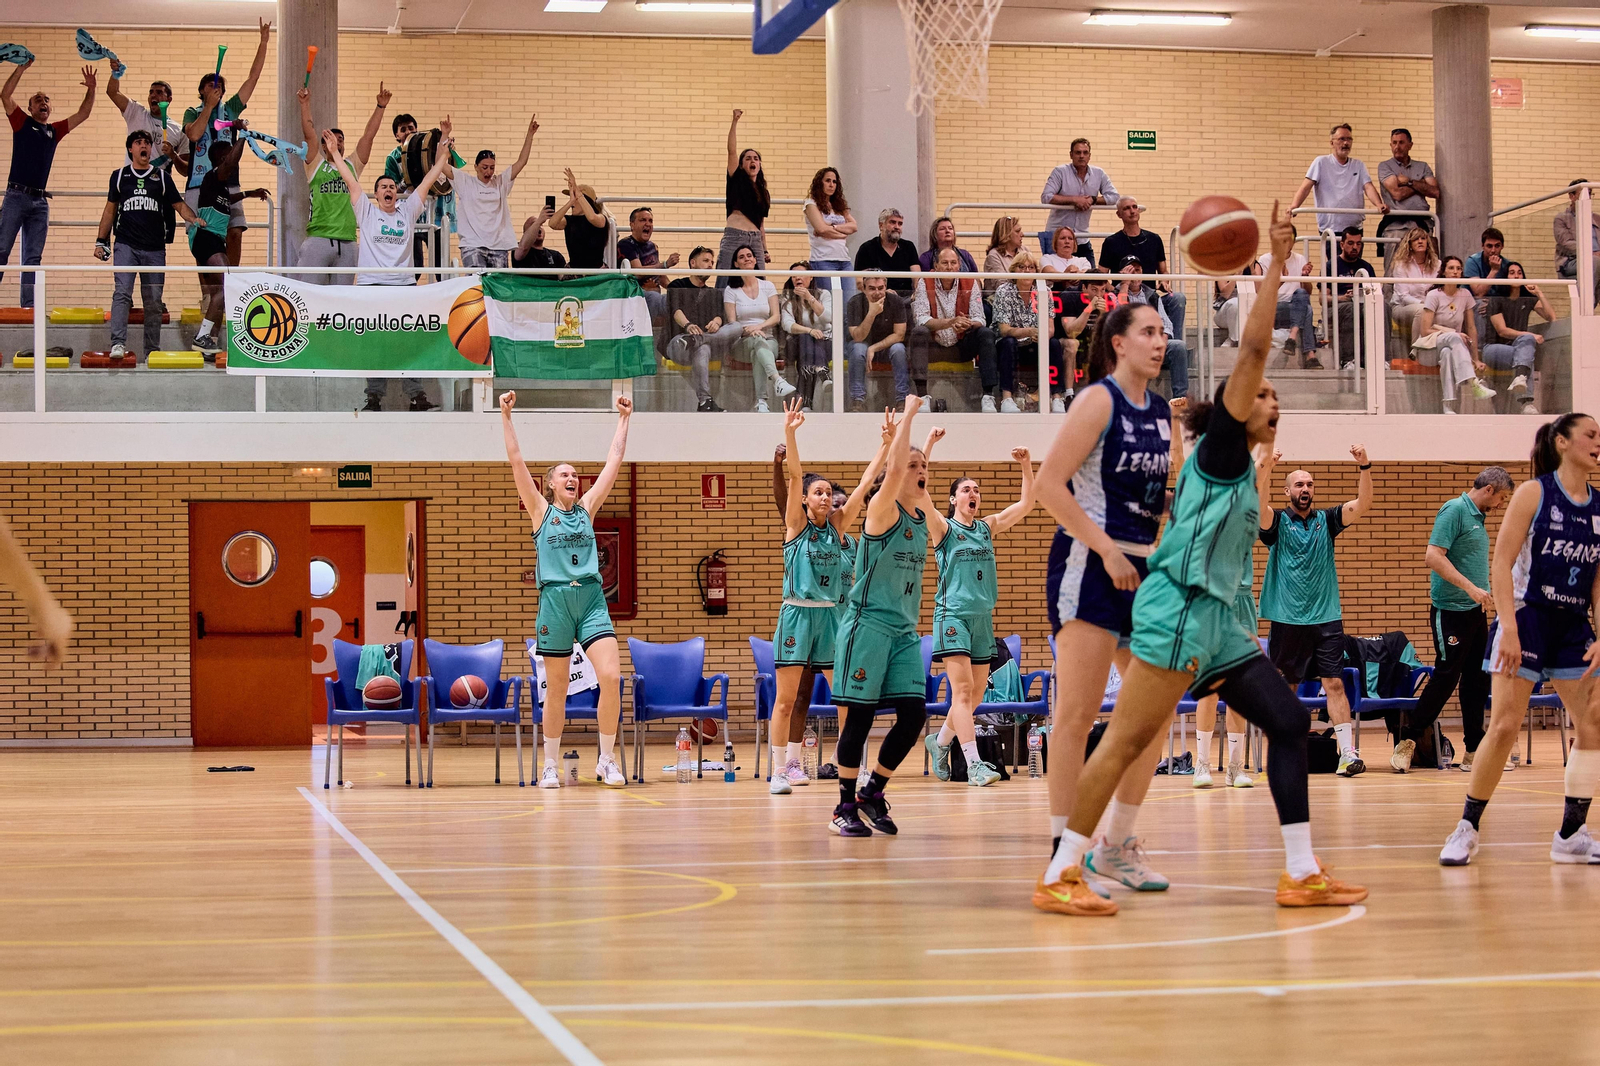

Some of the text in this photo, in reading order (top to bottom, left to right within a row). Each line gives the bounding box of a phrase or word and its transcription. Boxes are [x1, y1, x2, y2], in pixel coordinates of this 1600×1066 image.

[1128, 131, 1155, 139] SALIDA
[136, 179, 145, 189] 5
[320, 181, 350, 194] ESTEPO
[122, 195, 159, 212] ESTEPONA
[232, 282, 311, 334] CLUB AMIGOS BALONCESTO
[315, 312, 441, 335] #OrgulloCAB
[238, 335, 303, 359] ESTEPONA
[1115, 451, 1172, 478] LEGAN
[339, 472, 370, 481] SALIDA
[1144, 480, 1162, 504] 12
[571, 554, 579, 566] 6
[819, 575, 830, 587] 12
[976, 569, 983, 582] 8
[1568, 566, 1580, 586] 8
[904, 581, 915, 596] 14
